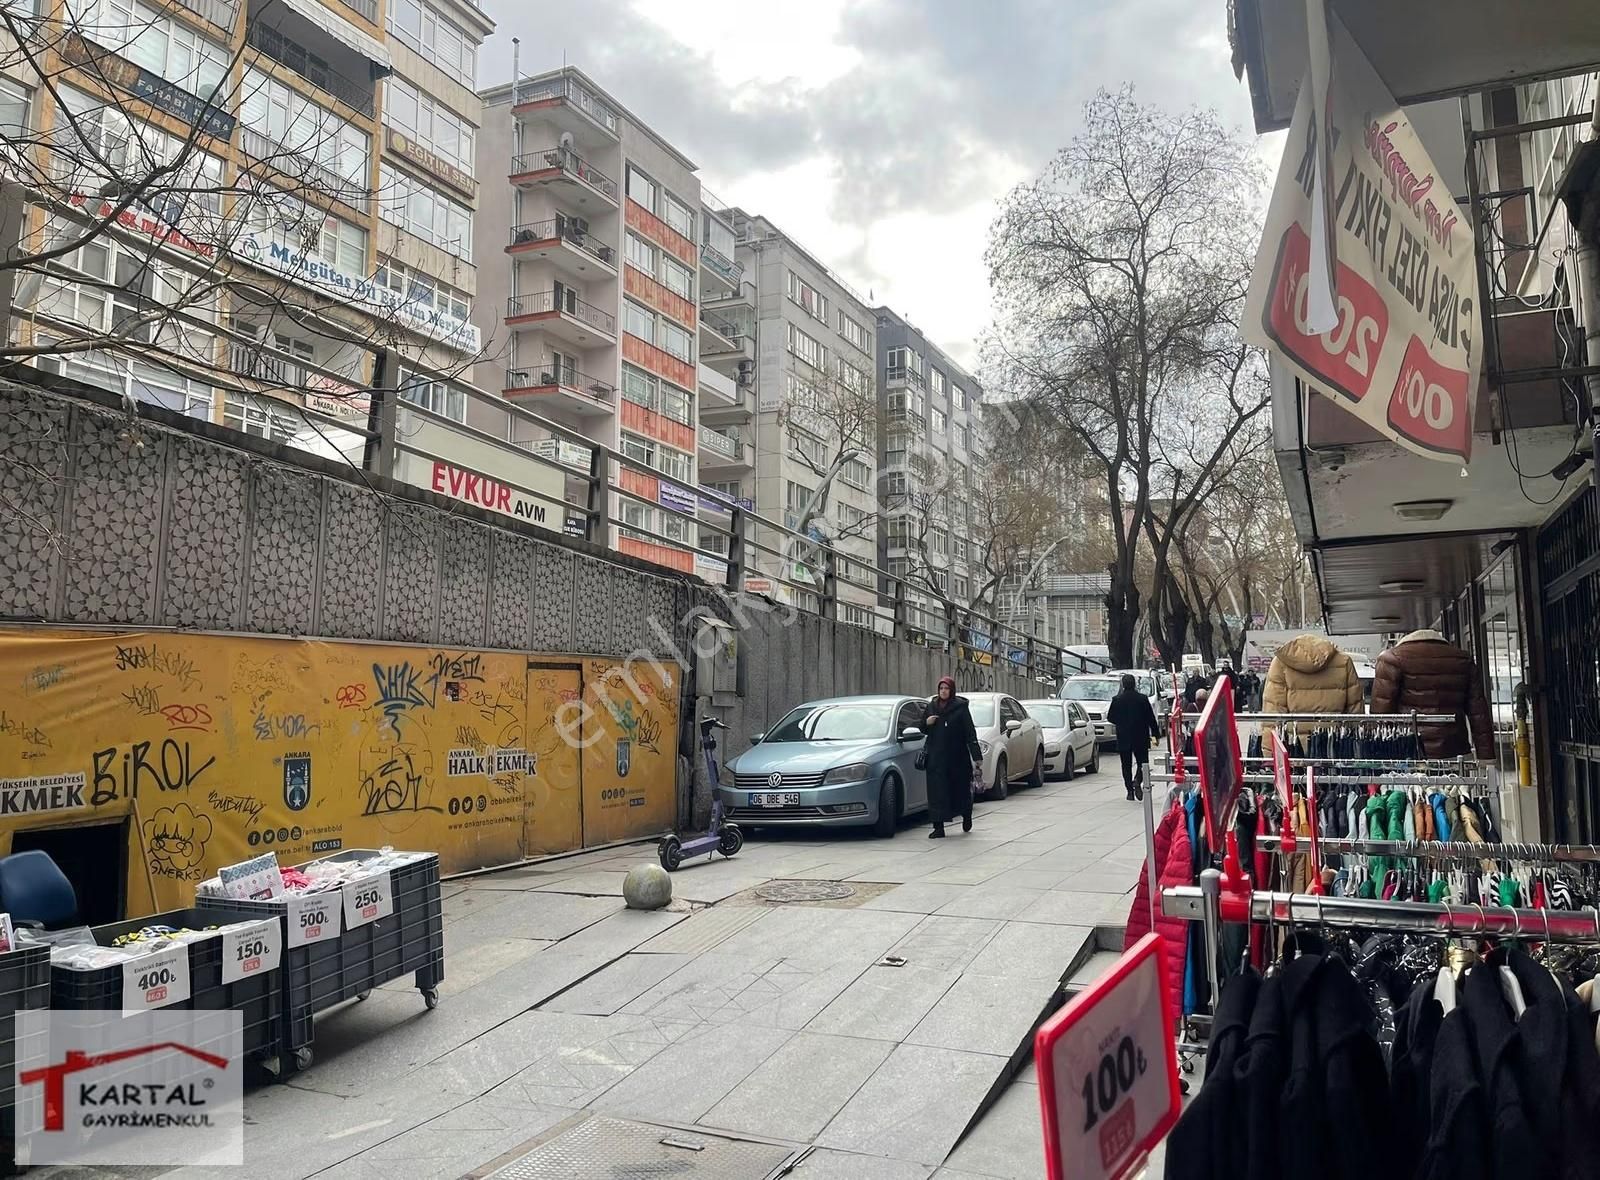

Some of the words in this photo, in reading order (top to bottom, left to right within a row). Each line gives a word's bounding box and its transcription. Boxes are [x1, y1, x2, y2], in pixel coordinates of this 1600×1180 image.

[431, 461, 512, 513] EVKUR
[514, 499, 546, 524] AVM
[284, 751, 311, 759] ANKARA
[449, 750, 475, 759] ANKARA
[448, 757, 485, 775] HALK
[40, 774, 84, 786] BELEDİYESİ
[753, 794, 763, 804] 06
[784, 794, 798, 804] 546
